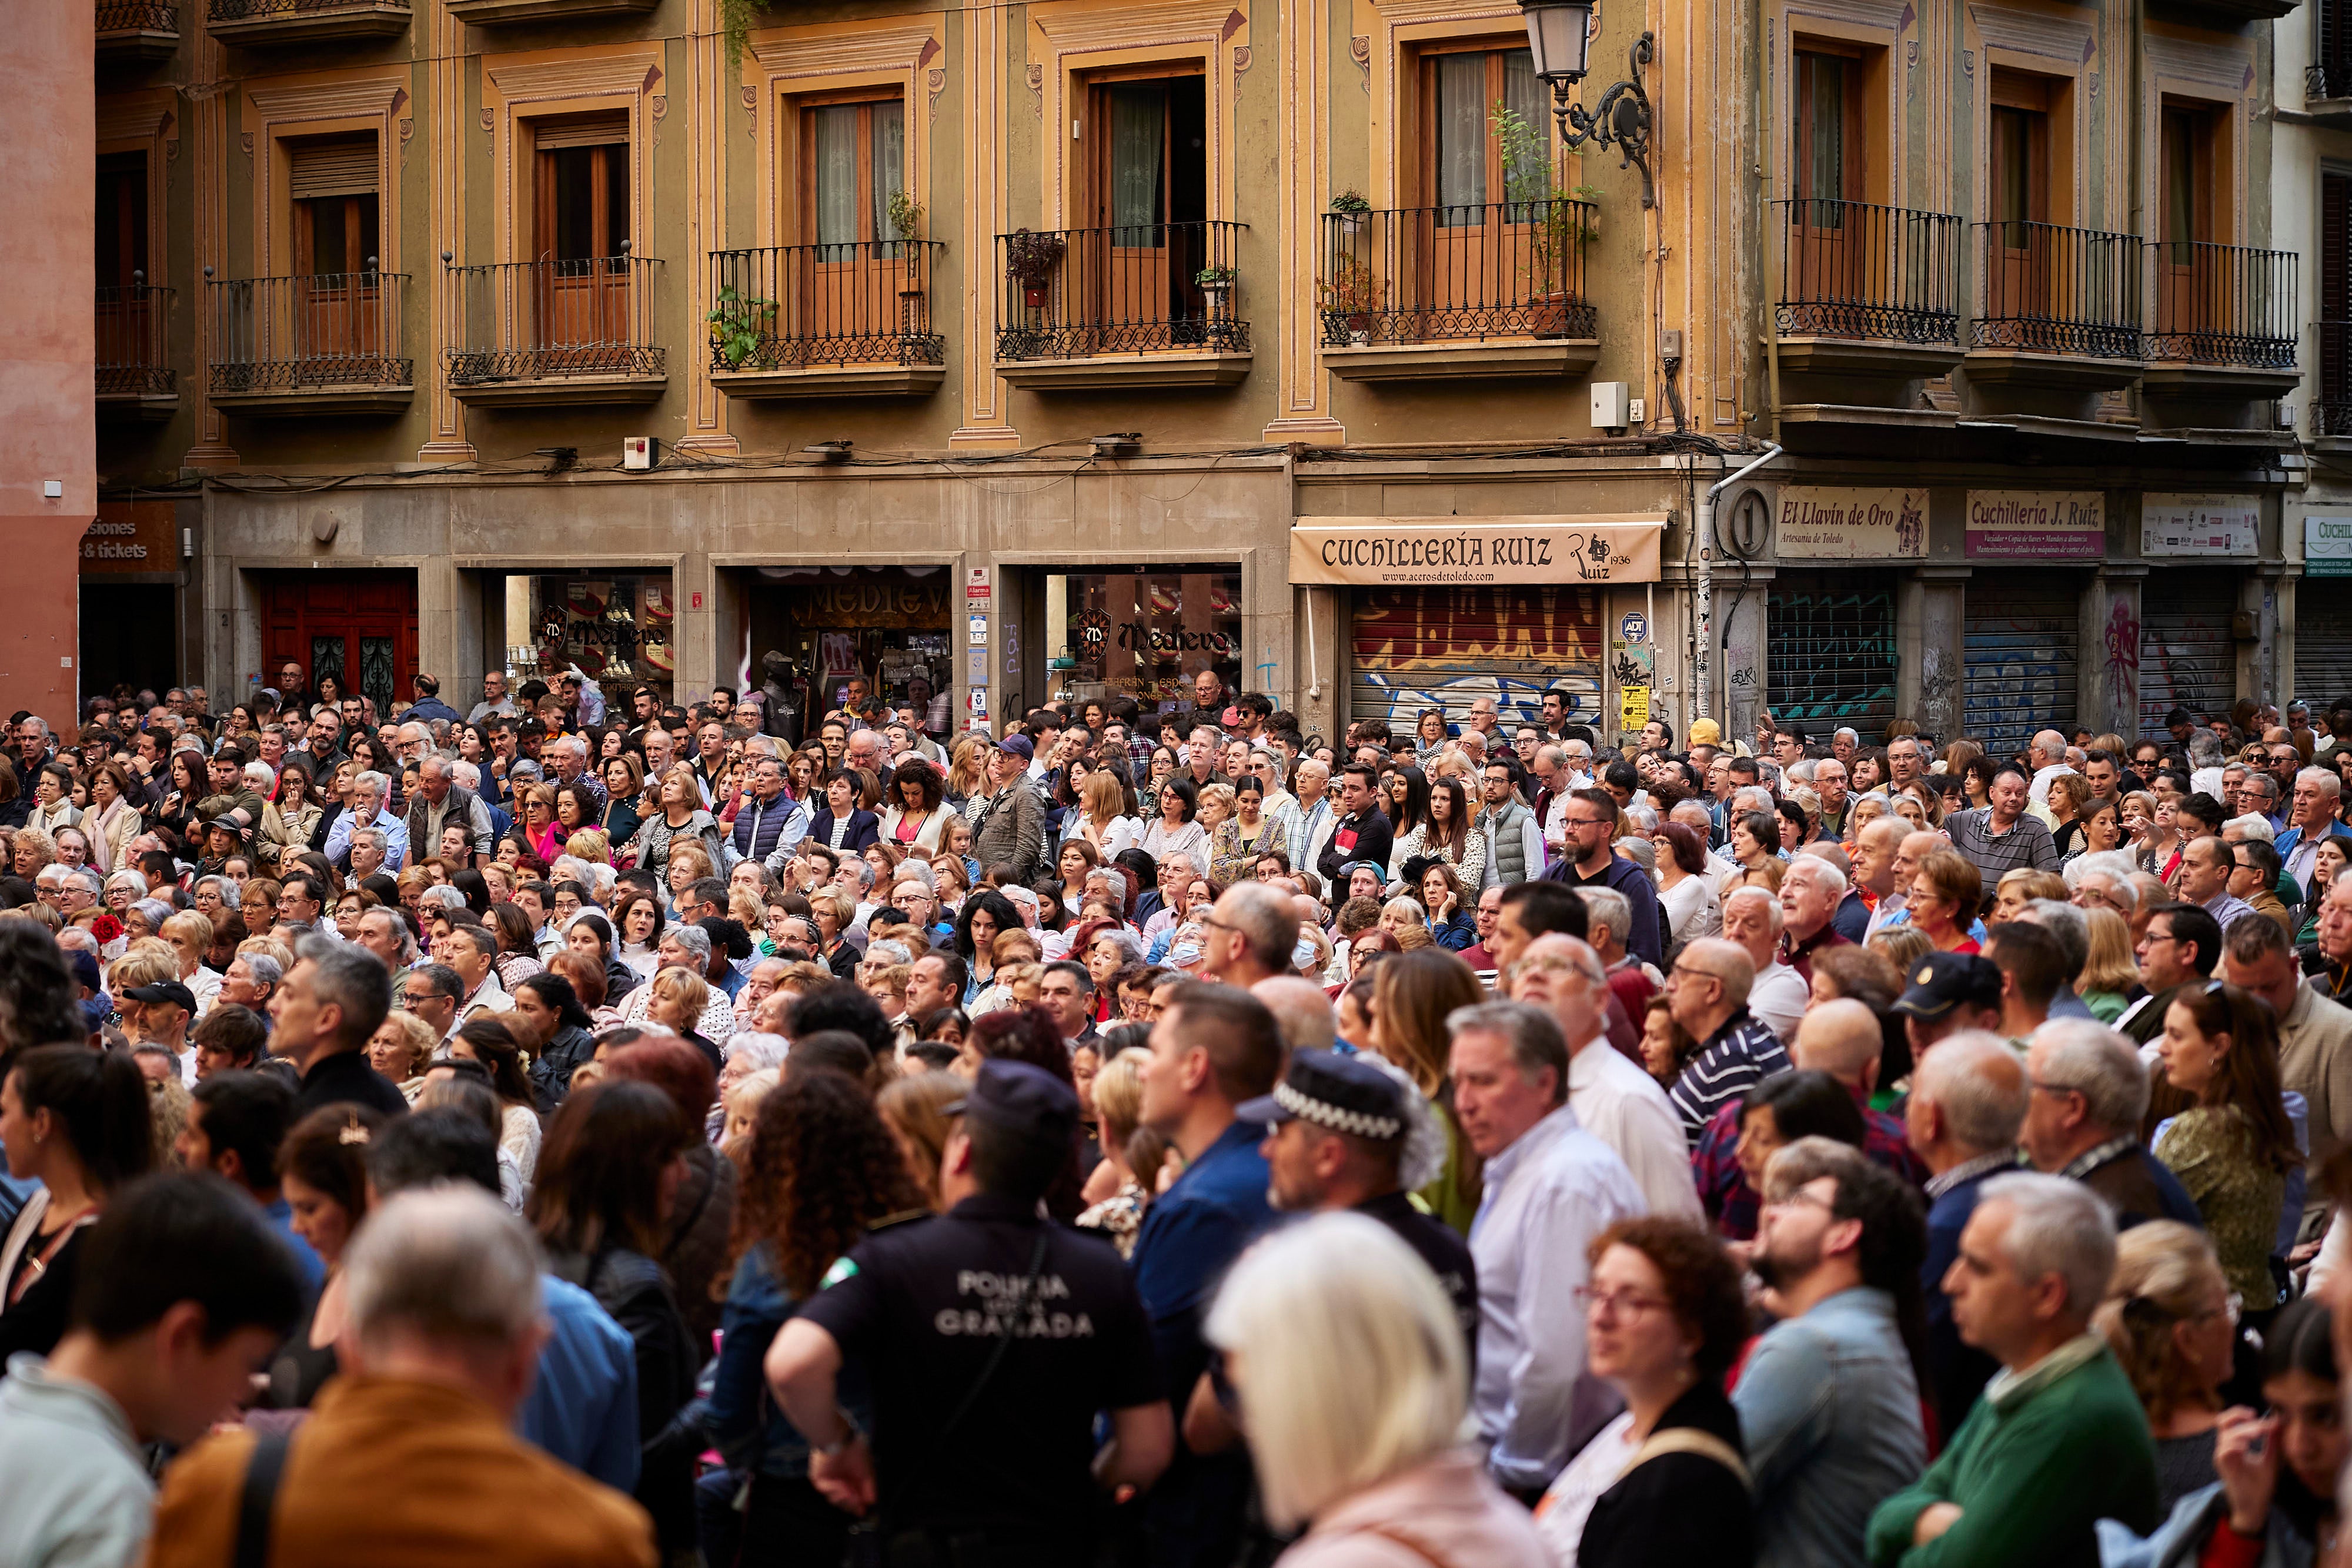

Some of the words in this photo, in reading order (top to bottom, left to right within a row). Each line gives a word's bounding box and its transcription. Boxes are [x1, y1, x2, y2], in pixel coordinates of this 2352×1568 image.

[1780, 501, 1798, 524] El
[1800, 502, 1844, 524] Llavín
[1848, 503, 1863, 526] de
[1868, 503, 1893, 526] Oro
[1972, 500, 2047, 525] Cuchillería
[2051, 502, 2062, 526] J.
[2067, 502, 2099, 527] Ruiz
[86, 519, 136, 535] siones
[1813, 533, 1820, 543] de
[1823, 533, 1843, 544] Toledo
[2008, 534, 2022, 544] Copia
[97, 541, 147, 558] tickets
[1322, 531, 1484, 567] CUCHILLERÍA
[1492, 536, 1552, 567] RUIZ
[2014, 546, 2030, 554] afilado
[1611, 556, 1631, 564] 1936
[1382, 571, 1494, 581] www.acerosdetoledo.com
[808, 585, 951, 621] MEDIEV
[573, 620, 666, 646] Medevo
[1625, 621, 1643, 631] ADT
[1118, 623, 1228, 651] Medievo
[1159, 677, 1197, 688] ESPECI
